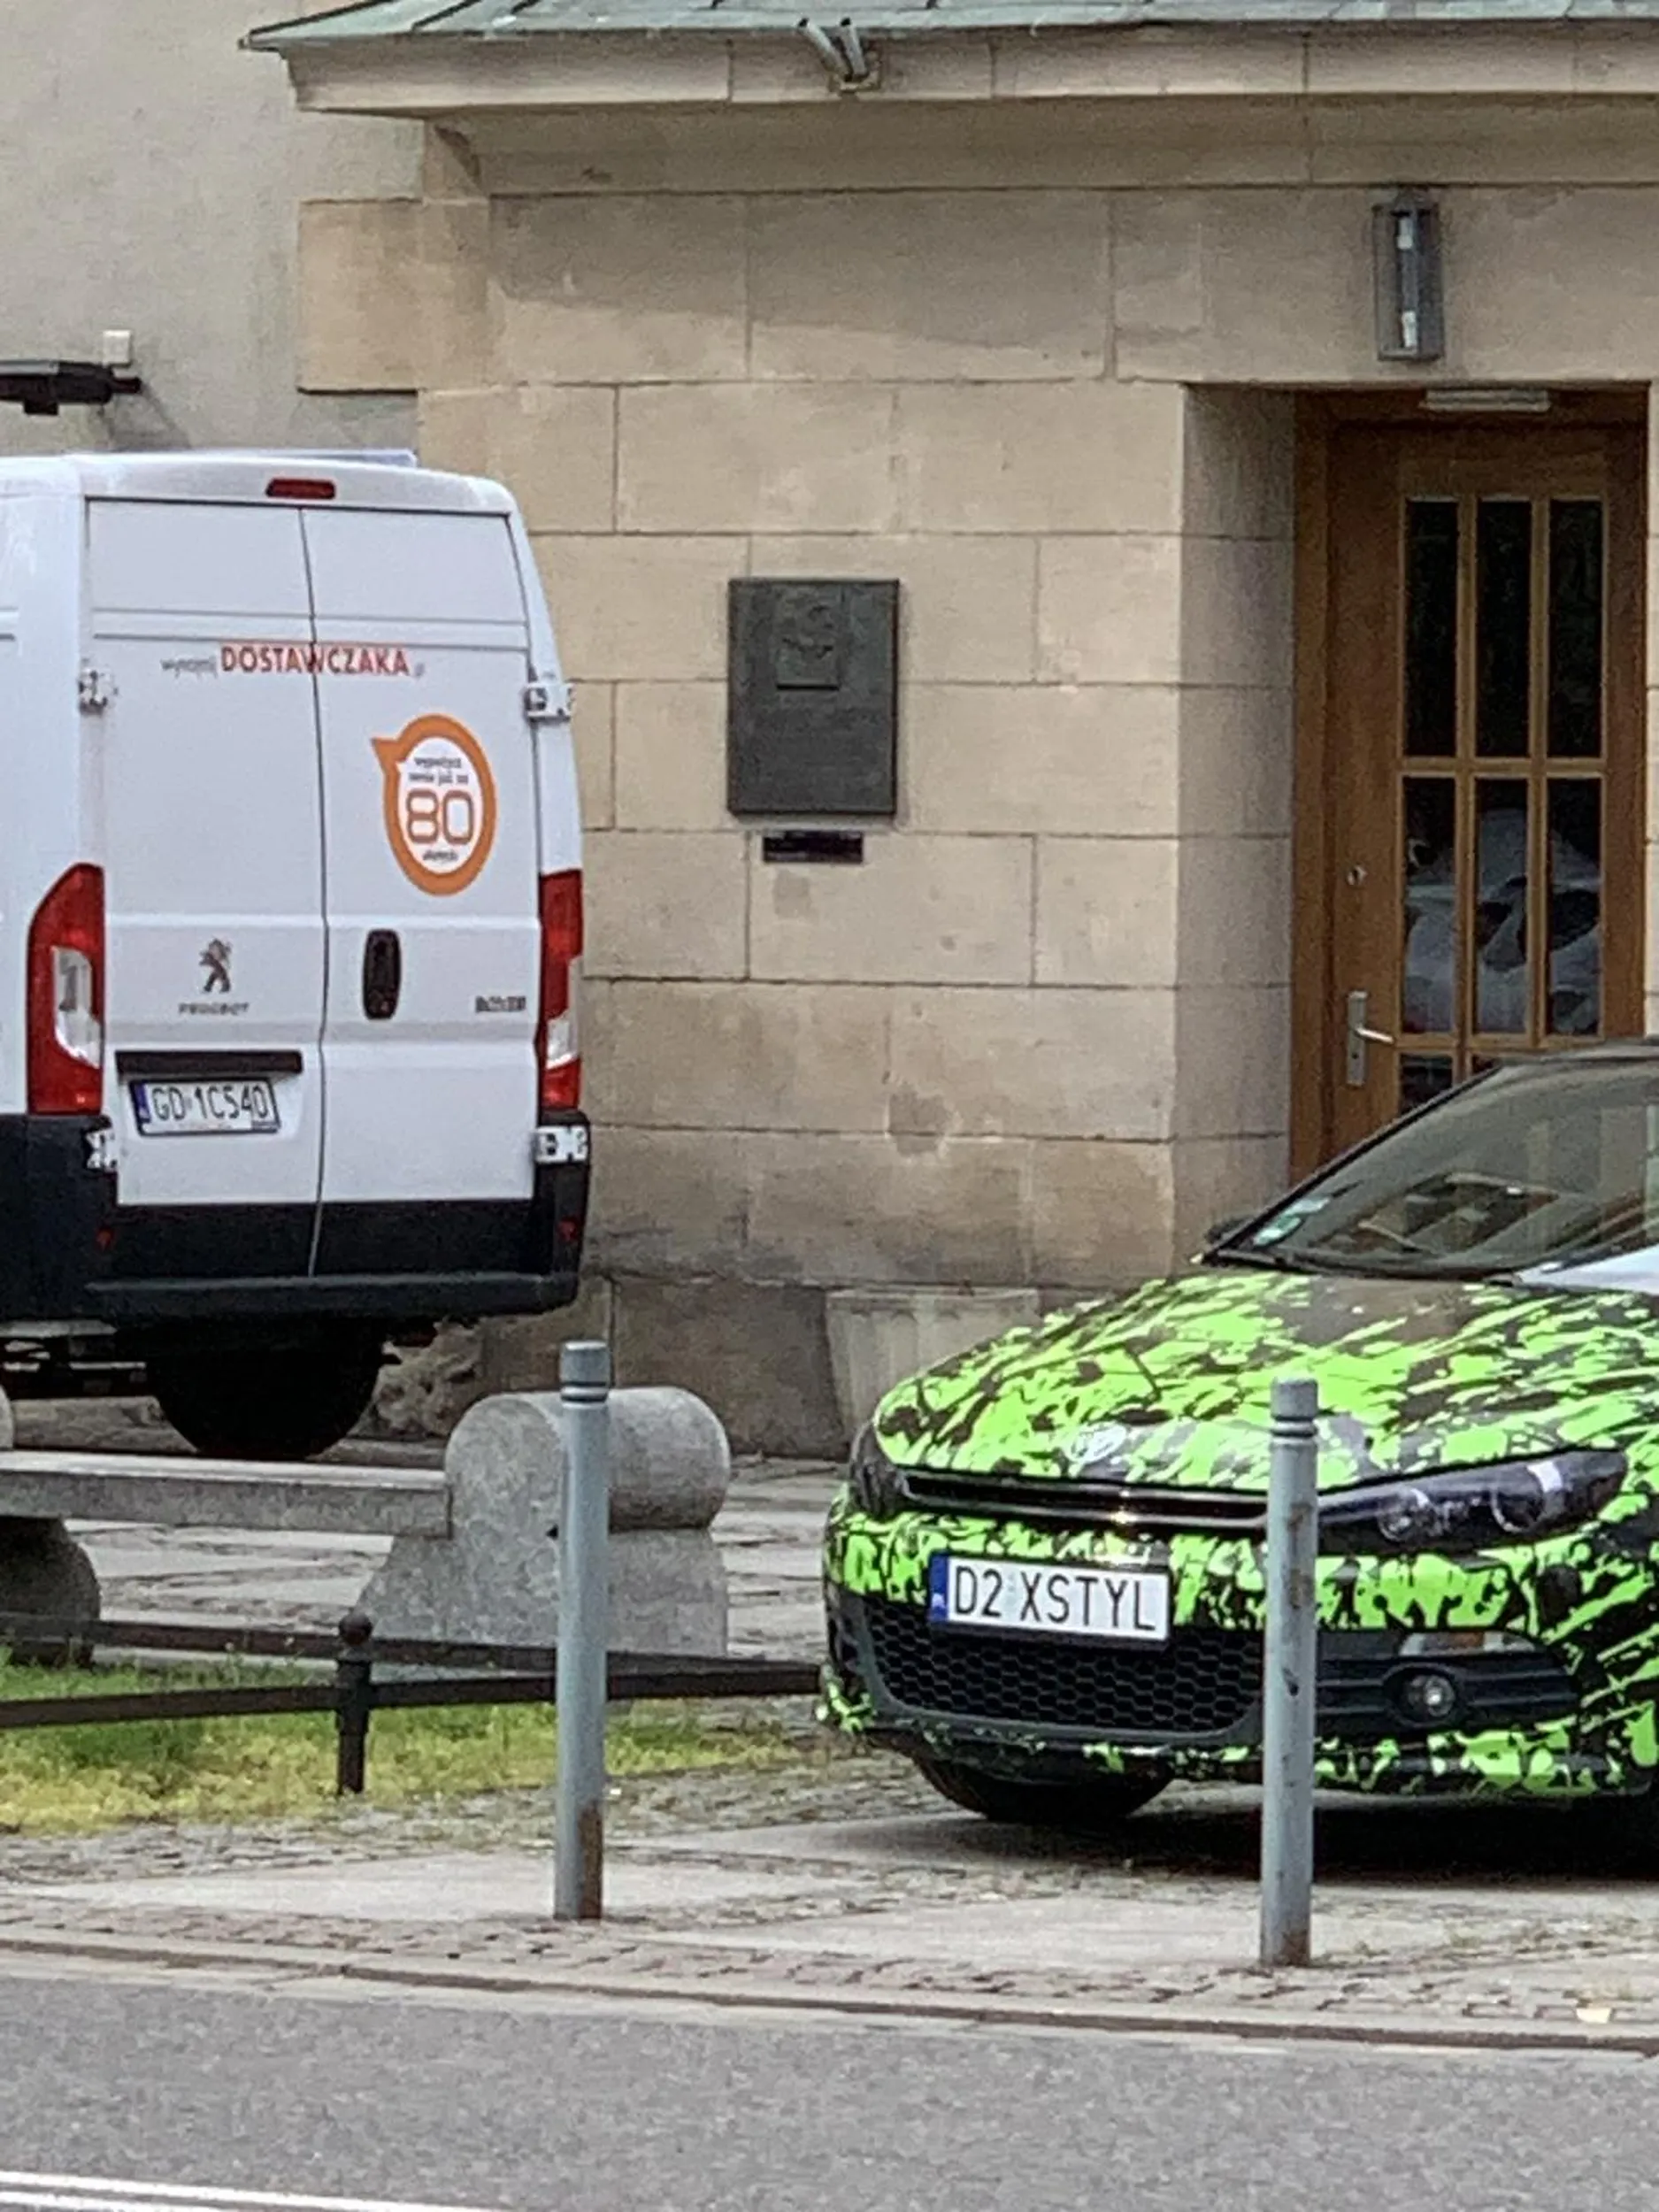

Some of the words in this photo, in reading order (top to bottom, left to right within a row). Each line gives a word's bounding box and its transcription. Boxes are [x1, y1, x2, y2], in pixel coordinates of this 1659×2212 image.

[220, 645, 411, 675] DOSTAWCZAKA
[405, 787, 474, 846] 80
[151, 1086, 186, 1121] GD
[955, 1565, 1003, 1617] D2
[1019, 1571, 1156, 1632] XSTYL
